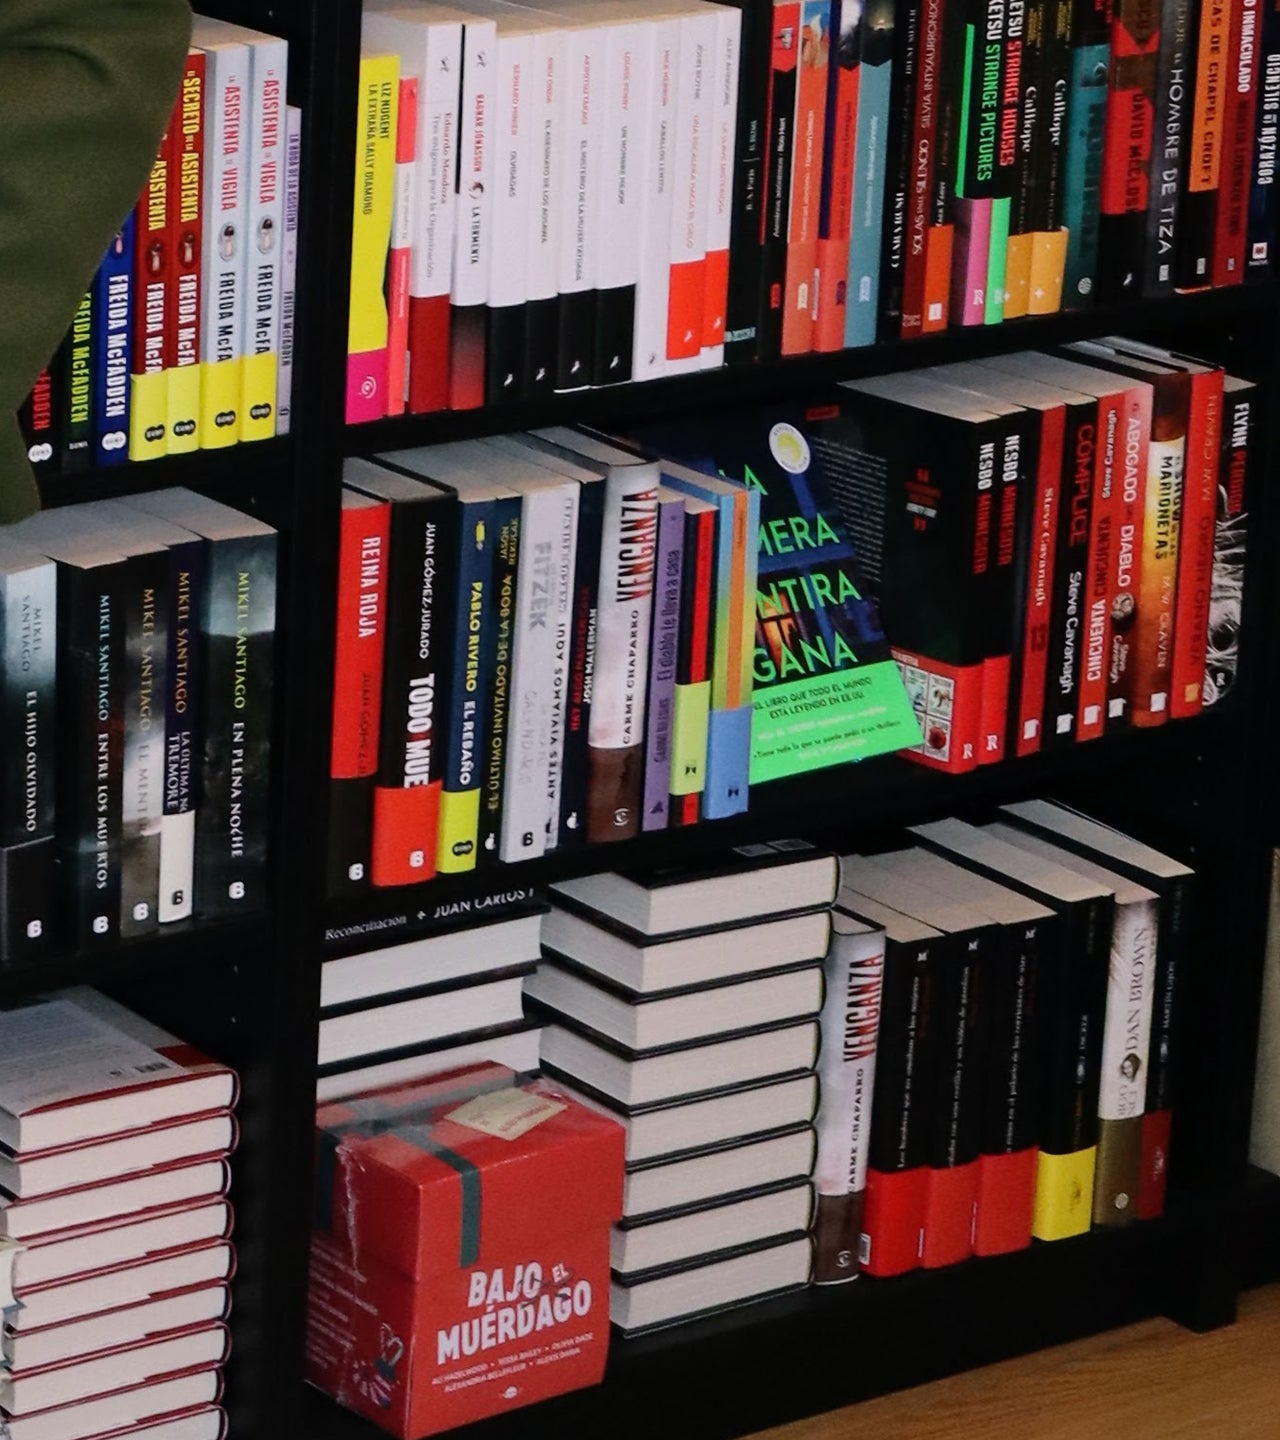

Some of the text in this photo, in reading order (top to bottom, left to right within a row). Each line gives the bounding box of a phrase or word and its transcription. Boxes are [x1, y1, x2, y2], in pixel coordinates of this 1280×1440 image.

[359, 537, 381, 638] REINA ROJA
[465, 581, 483, 692] PABLO RIVERO
[26, 691, 38, 833] EL HIJO OLVIDADO
[437, 1279, 592, 1366] MUÉRDAGO
[468, 1262, 569, 1307] BAJO EL
